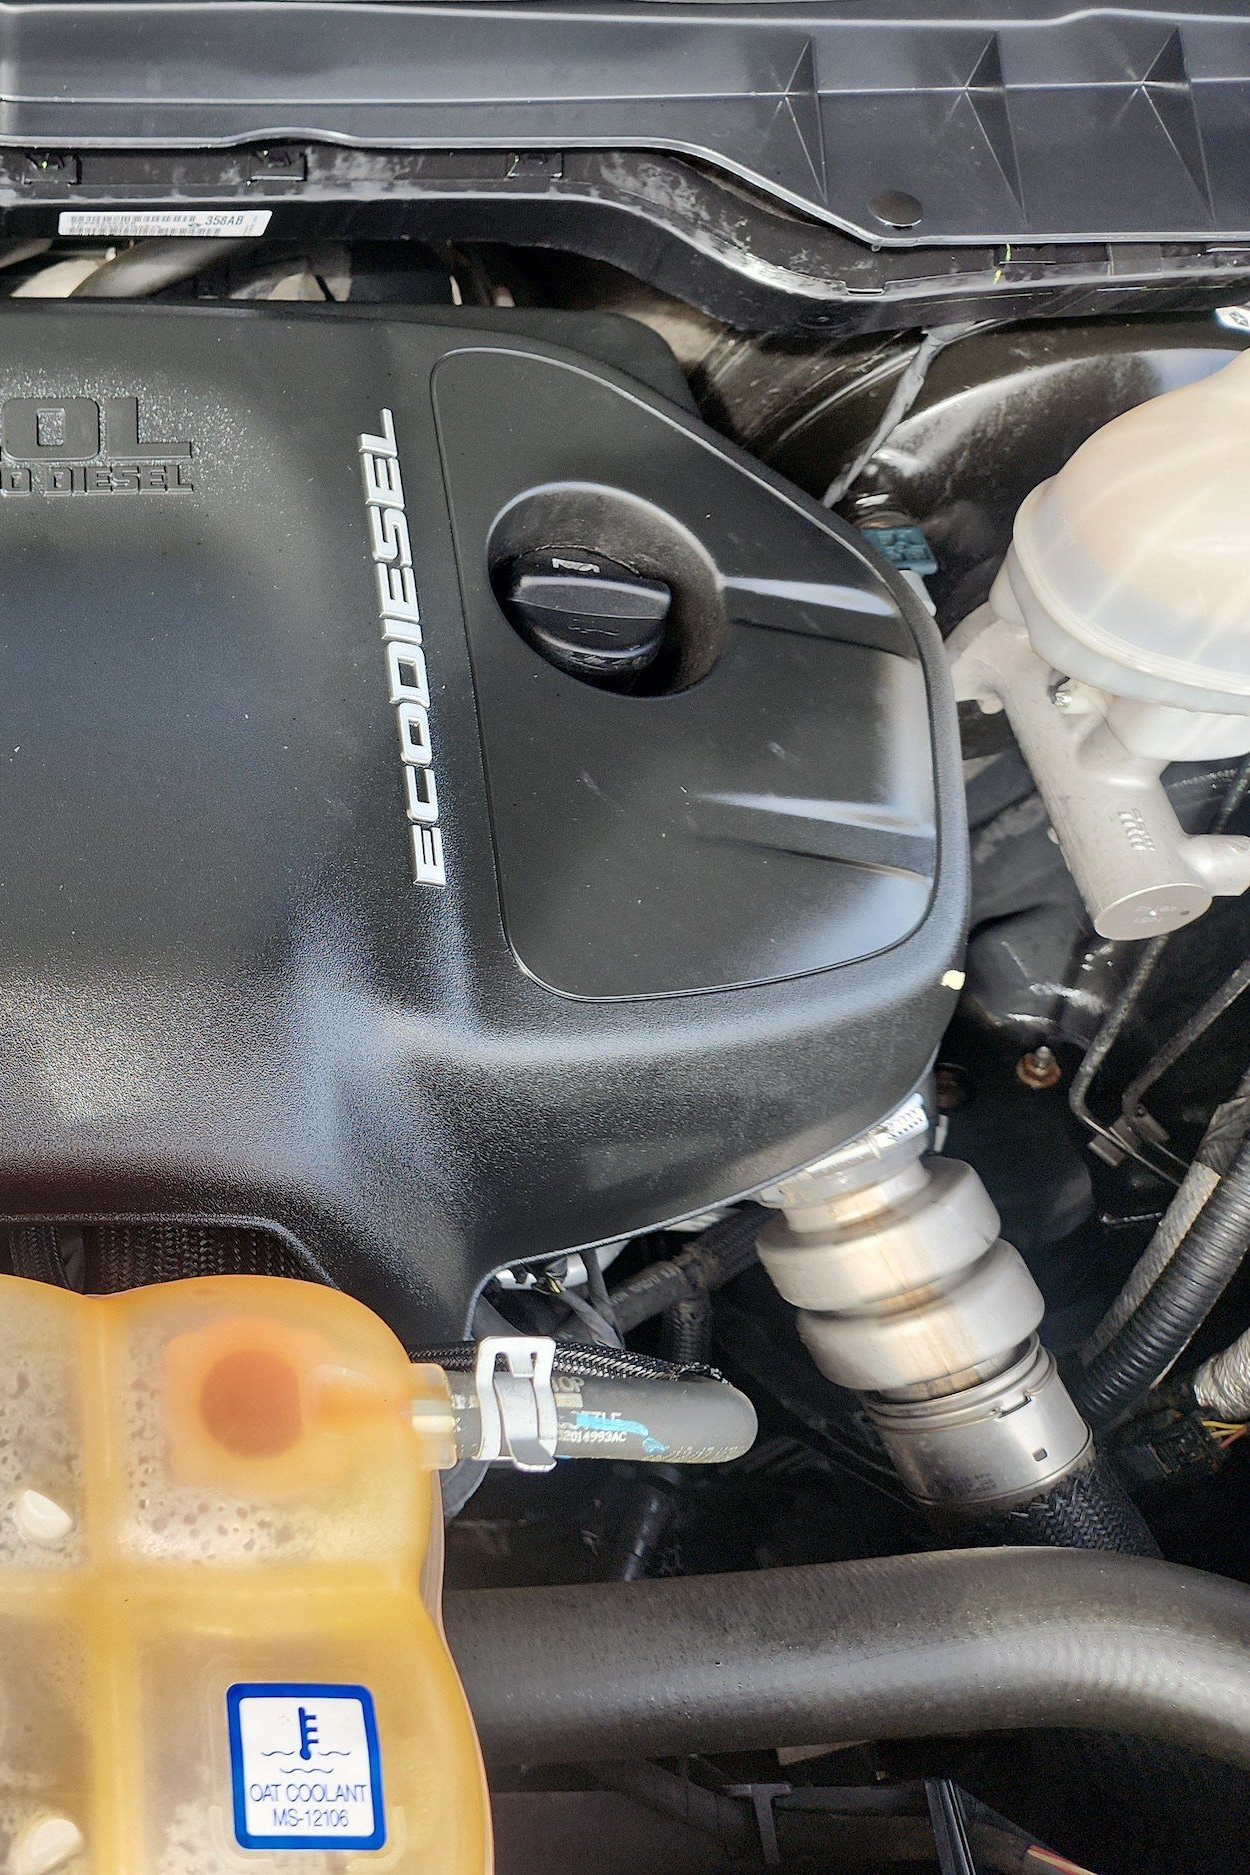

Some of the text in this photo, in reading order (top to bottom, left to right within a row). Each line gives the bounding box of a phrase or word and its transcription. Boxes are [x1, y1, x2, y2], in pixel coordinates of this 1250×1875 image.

[43, 464, 195, 496] DIESEL
[358, 407, 447, 888] ECODIESEL
[249, 1783, 368, 1803] OAT COOLANT
[273, 1807, 350, 1828] MS-12106
